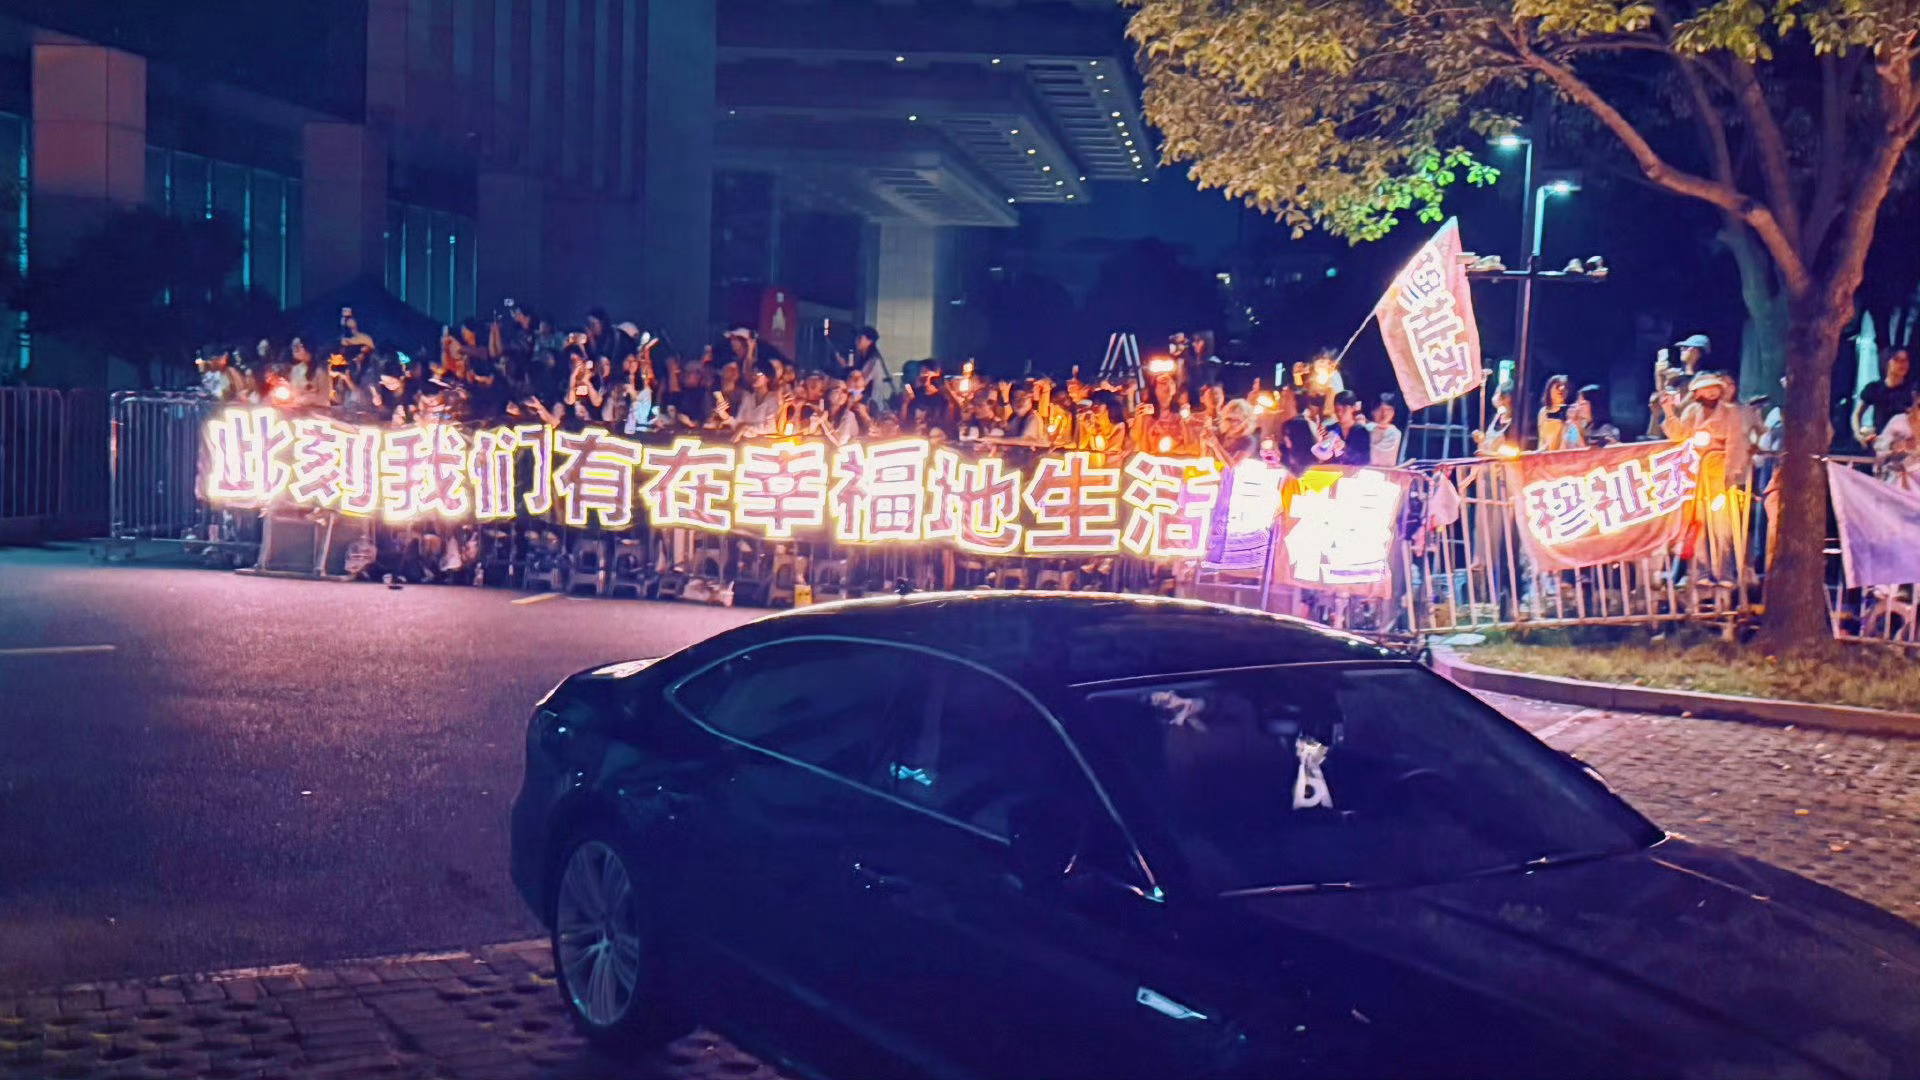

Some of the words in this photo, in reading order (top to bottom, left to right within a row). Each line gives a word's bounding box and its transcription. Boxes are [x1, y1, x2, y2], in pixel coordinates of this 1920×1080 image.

[207, 407, 1221, 556] 此刻我们有在幸福地生活
[1523, 441, 1699, 545] 穆祉丞
